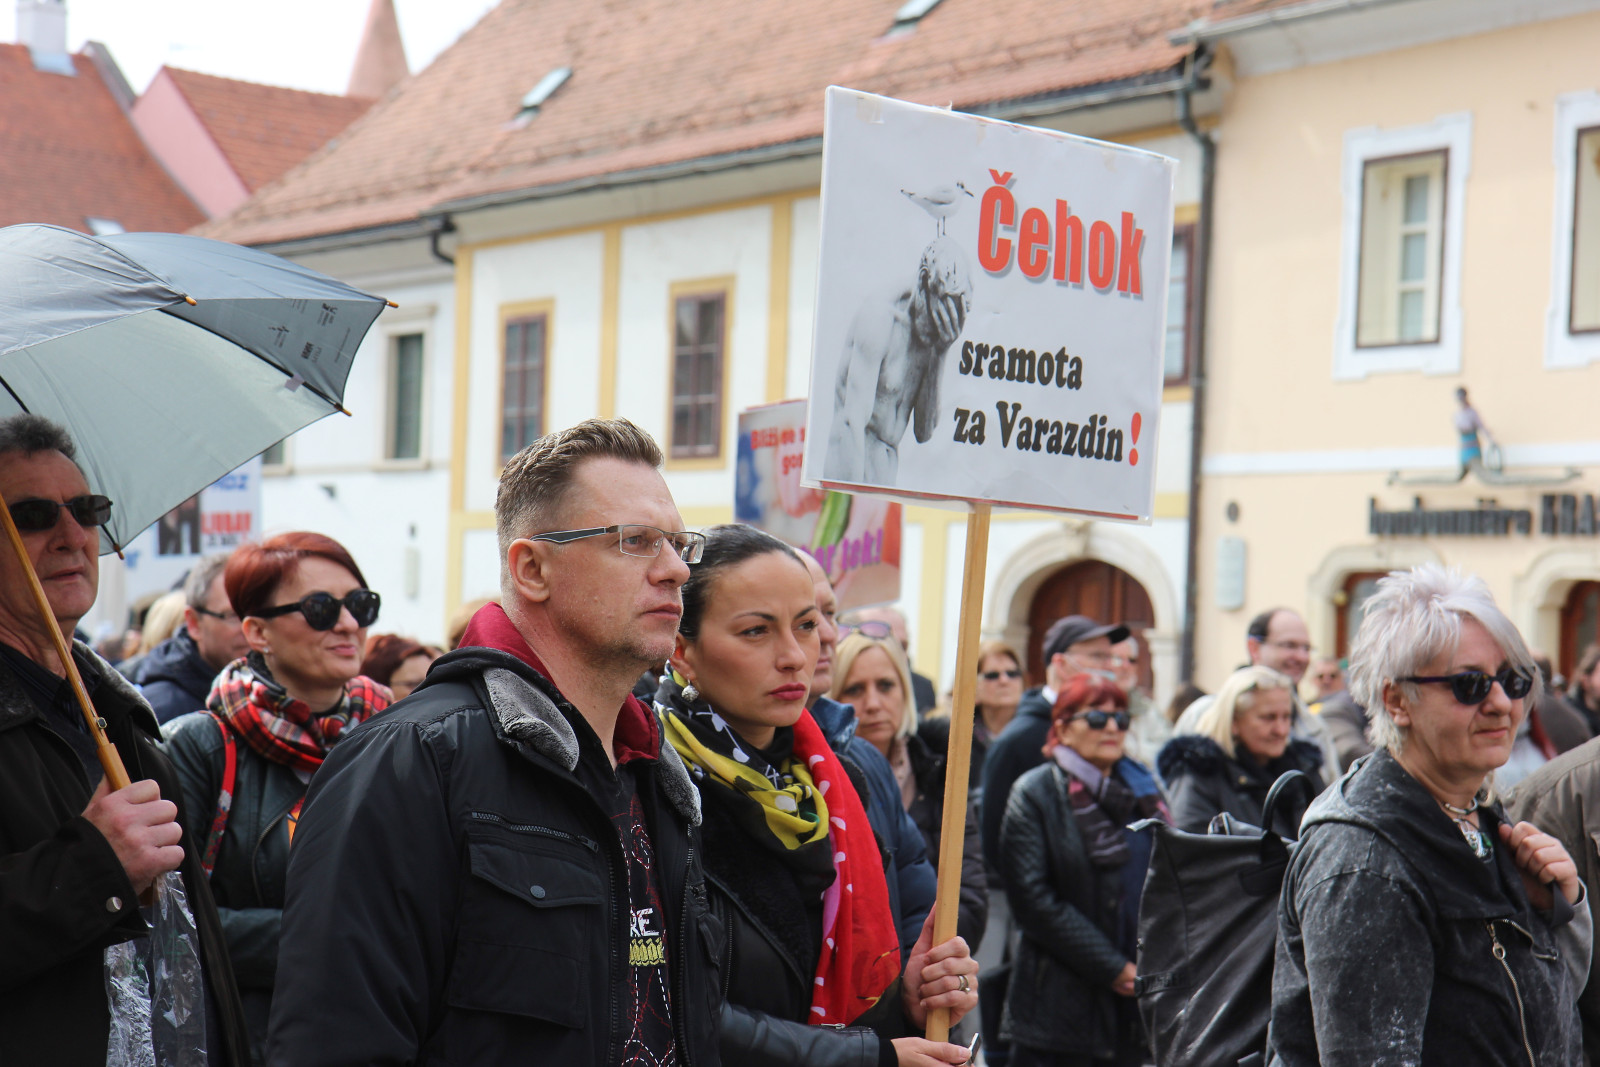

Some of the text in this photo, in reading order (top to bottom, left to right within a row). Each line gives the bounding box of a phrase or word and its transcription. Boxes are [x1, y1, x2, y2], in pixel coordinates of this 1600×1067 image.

[978, 168, 1144, 297] Čehok
[959, 340, 1083, 390] sramota
[953, 407, 986, 446] za
